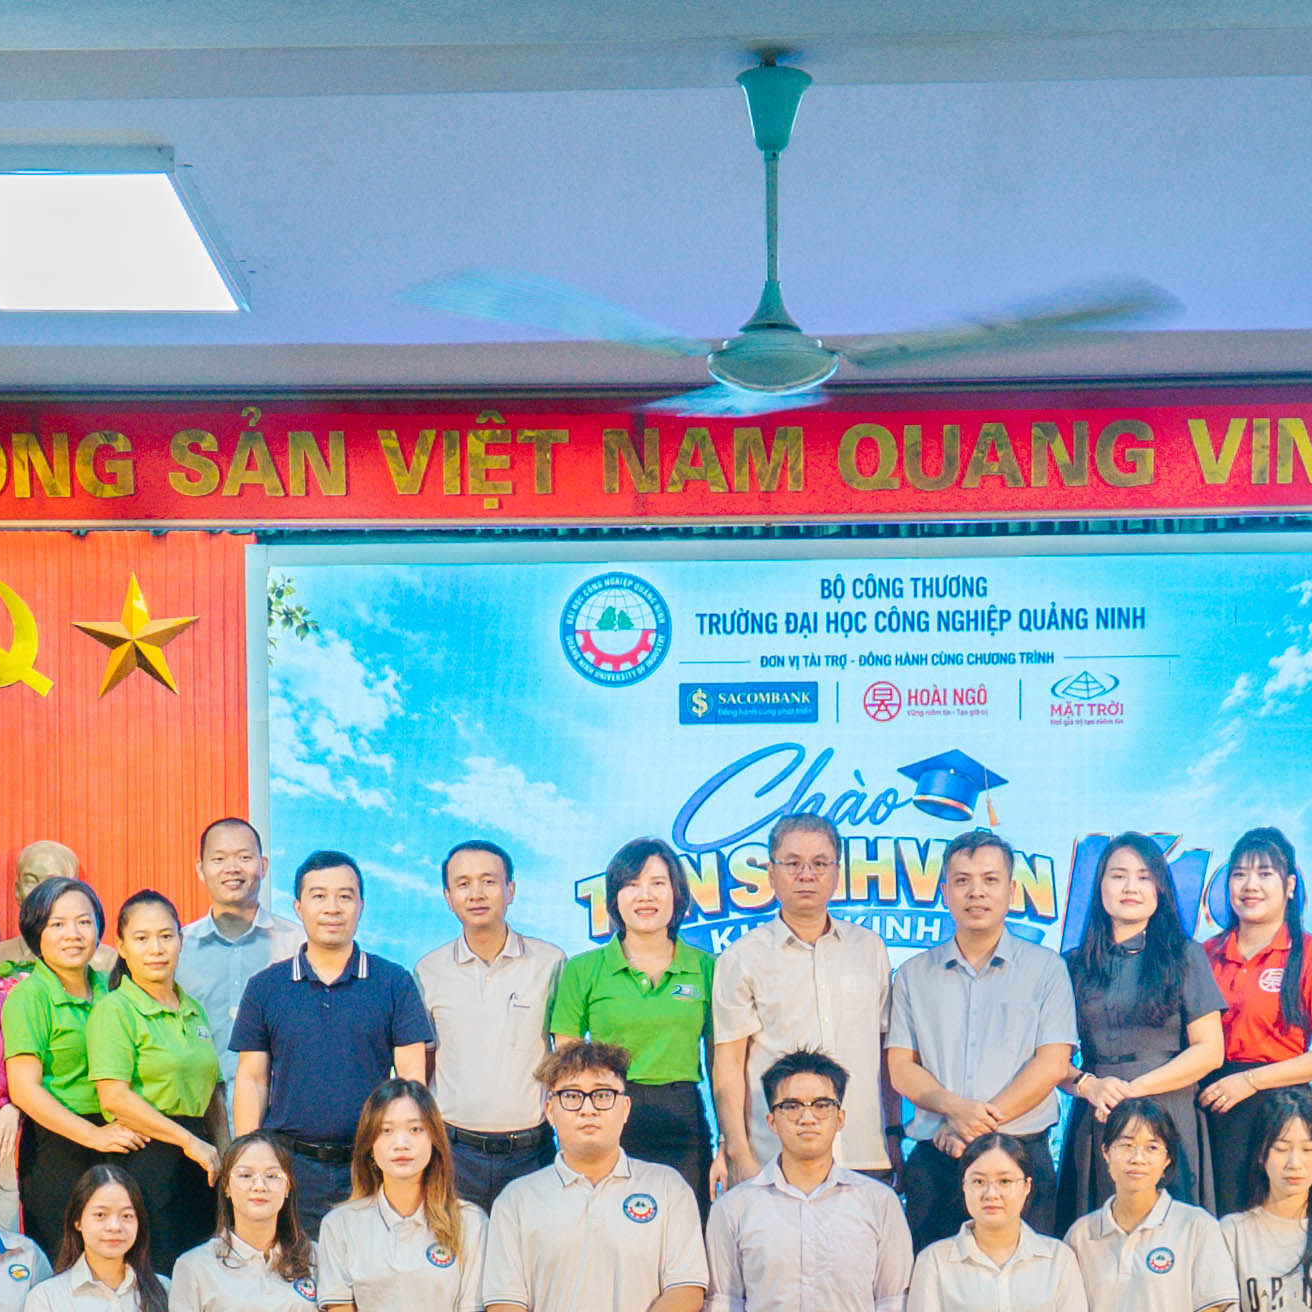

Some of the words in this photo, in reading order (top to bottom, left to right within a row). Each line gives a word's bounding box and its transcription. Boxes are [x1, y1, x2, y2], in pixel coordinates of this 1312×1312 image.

[169, 407, 346, 496] SẢN
[378, 412, 568, 509] VIỆT
[604, 428, 803, 493] NAM
[838, 423, 1154, 490] QUANG
[820, 573, 846, 604] BỘ
[852, 572, 904, 600] CÔNG
[909, 574, 988, 599] THƯƠNG
[694, 607, 779, 636] TRƯỜNG
[784, 611, 819, 640] ĐẠI
[825, 610, 868, 639] HỌC
[873, 605, 930, 634] CÔNG
[936, 603, 1012, 637] NGHIỆP
[1018, 601, 1089, 633] QUẢNG
[1095, 606, 1146, 631] NINH
[717, 690, 811, 705] SACOMBANK
[907, 684, 948, 707] HOÀI
[952, 683, 988, 706] NGÔ
